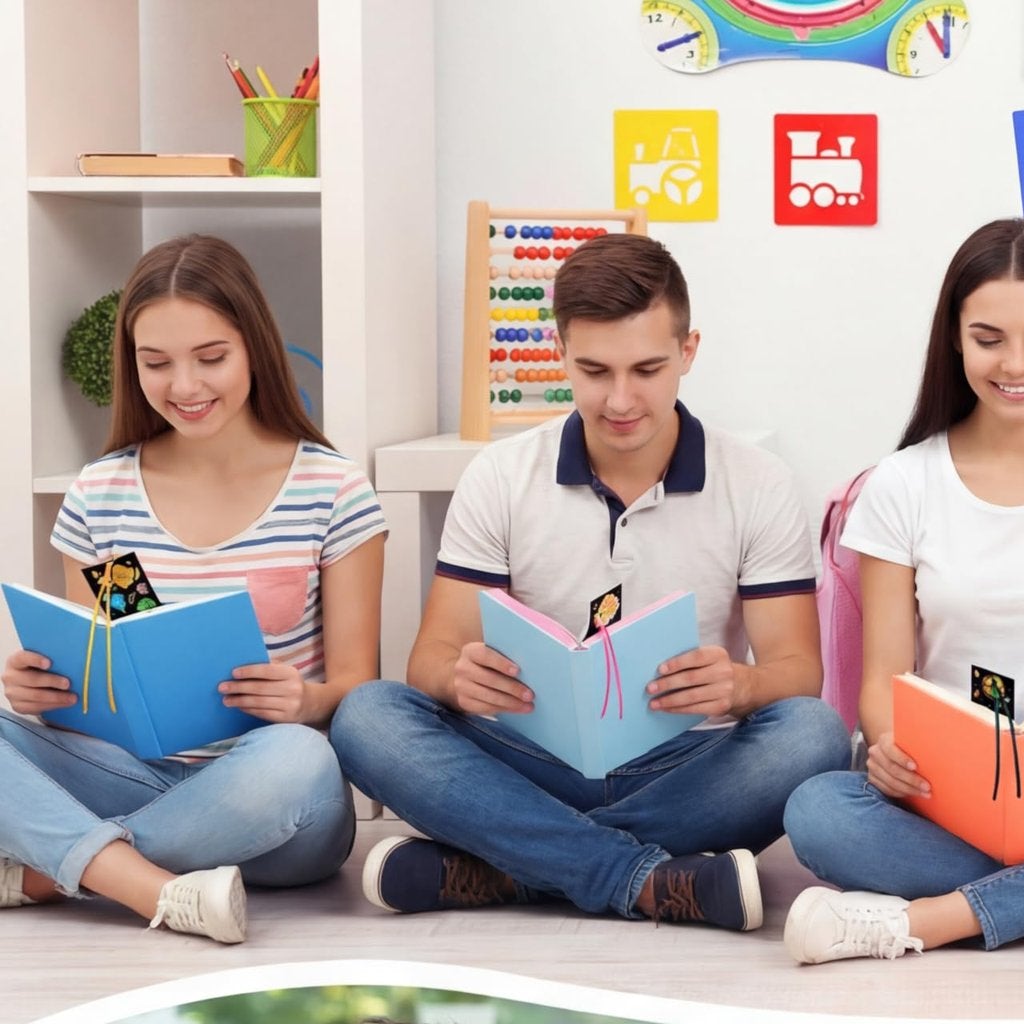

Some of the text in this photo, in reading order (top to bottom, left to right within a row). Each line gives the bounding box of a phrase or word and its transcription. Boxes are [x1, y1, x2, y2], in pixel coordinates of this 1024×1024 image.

[648, 13, 663, 24] 12
[686, 50, 695, 59] 3
[910, 50, 917, 59] 9
